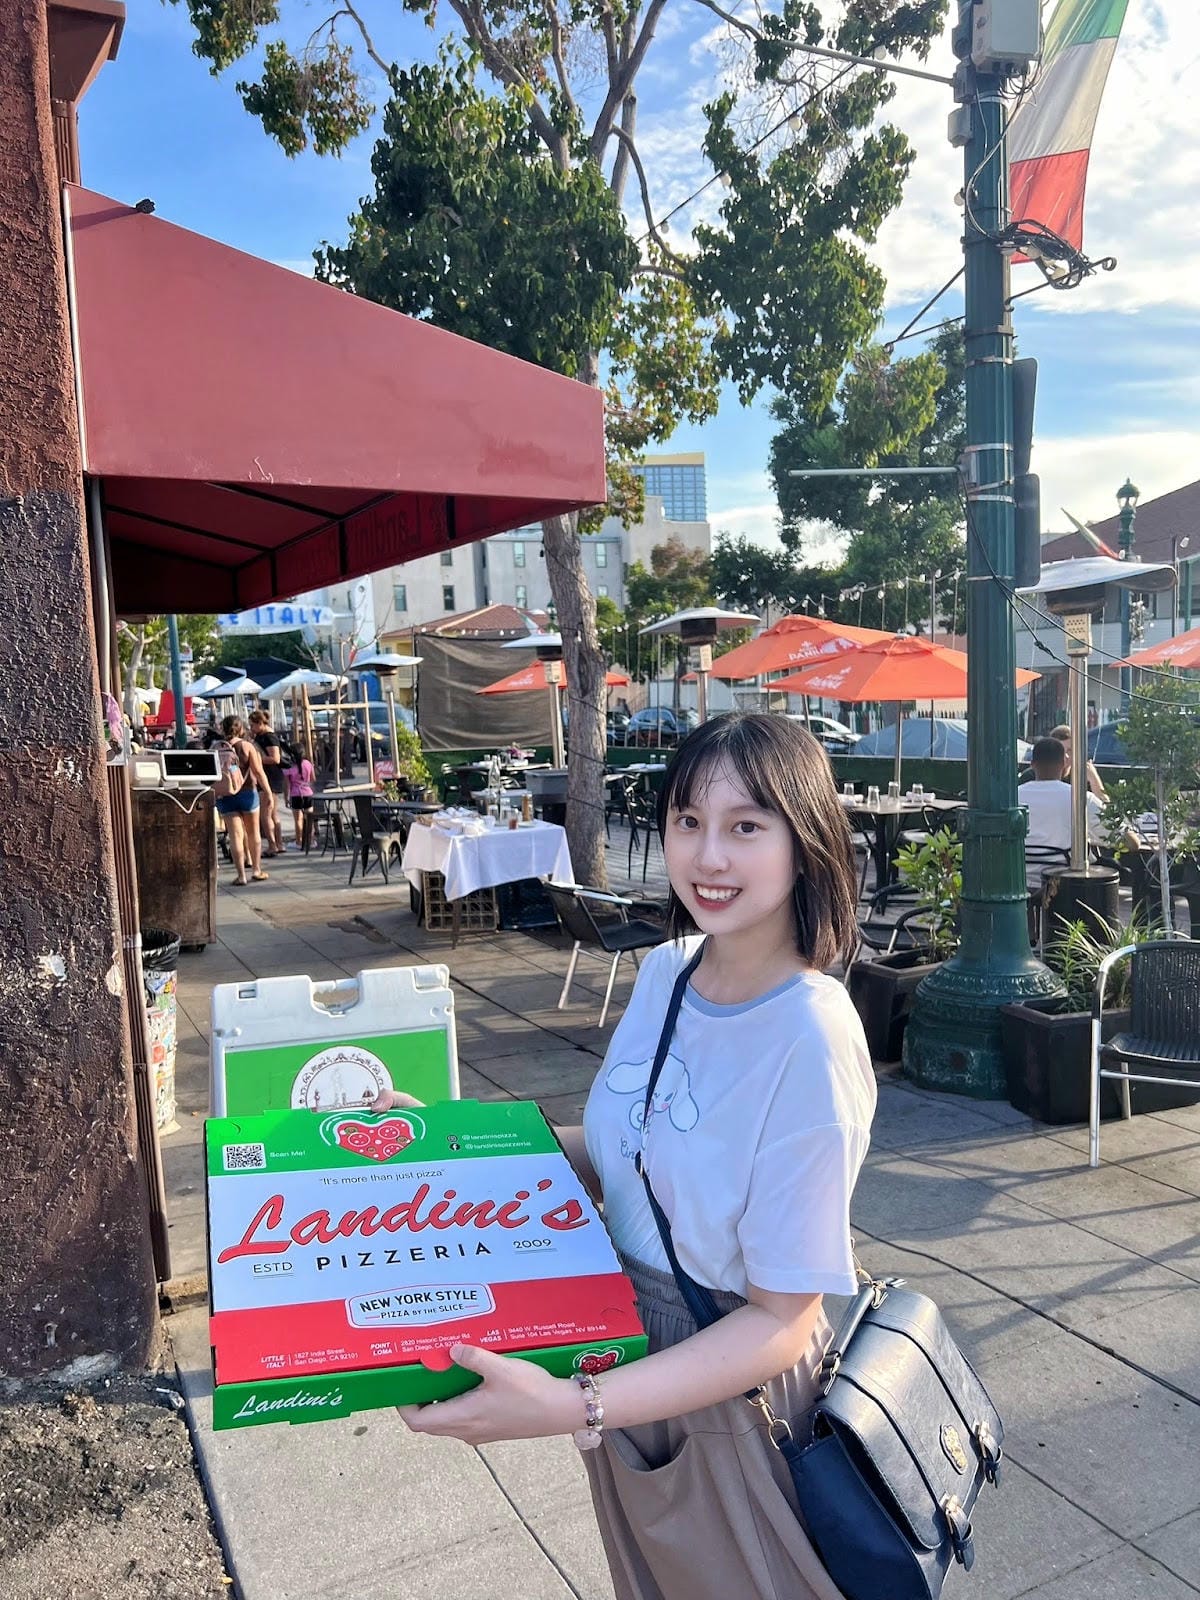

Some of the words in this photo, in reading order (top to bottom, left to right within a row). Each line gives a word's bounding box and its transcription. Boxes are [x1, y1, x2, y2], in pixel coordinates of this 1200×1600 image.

[255, 607, 322, 625] ITALY
[341, 1176, 368, 1184] more
[370, 1174, 393, 1182] than
[395, 1171, 414, 1181] just
[217, 1178, 591, 1264] Landini's
[253, 1261, 293, 1274] ESTD
[316, 1241, 492, 1271] PIZZERIA
[513, 1238, 552, 1249] 2009
[360, 1297, 391, 1313] NEW
[394, 1292, 433, 1306] YORK
[435, 1290, 478, 1301] STYLE
[380, 1310, 410, 1319] PIZZA
[438, 1303, 465, 1313] SLICE
[533, 1323, 557, 1331] Russell
[416, 1336, 438, 1345] Historic
[479, 1335, 502, 1343] VEGAS
[370, 1341, 391, 1350] POINT
[402, 1345, 414, 1353] San
[434, 1342, 444, 1350] CA
[294, 1352, 309, 1360] 1827
[310, 1350, 326, 1358] India
[326, 1347, 345, 1356] Street
[372, 1348, 393, 1356] LOMA
[260, 1354, 285, 1363] LITTLE
[294, 1358, 307, 1366] San
[265, 1361, 286, 1369] ITALY
[232, 1387, 344, 1420] Landini's
